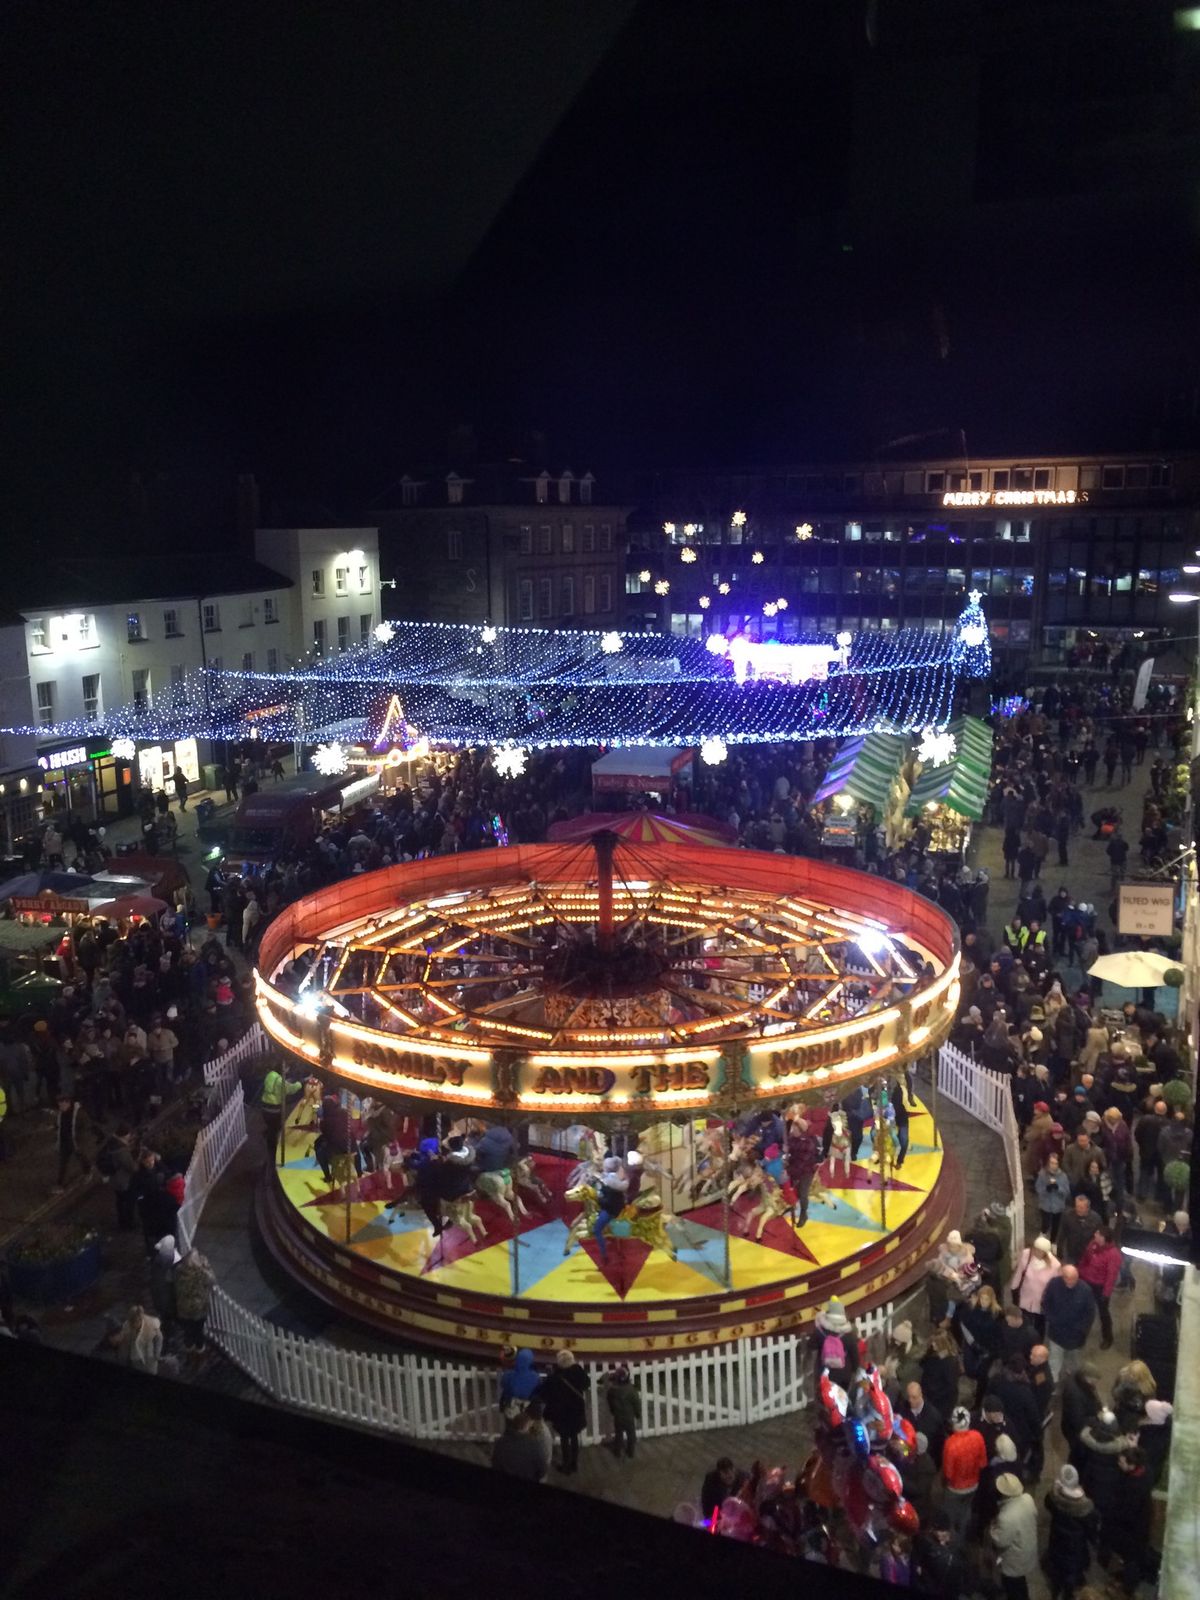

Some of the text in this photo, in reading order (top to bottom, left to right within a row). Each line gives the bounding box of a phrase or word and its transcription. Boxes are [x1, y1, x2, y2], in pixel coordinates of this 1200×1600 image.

[943, 490, 1076, 505] MERRY CHRISTMAS
[352, 1038, 472, 1087] FAMILY
[532, 1066, 616, 1096] AND
[629, 1060, 711, 1093] THE
[768, 1024, 885, 1079] NOBILITY
[456, 1324, 512, 1343] SET
[541, 1337, 577, 1348] OF
